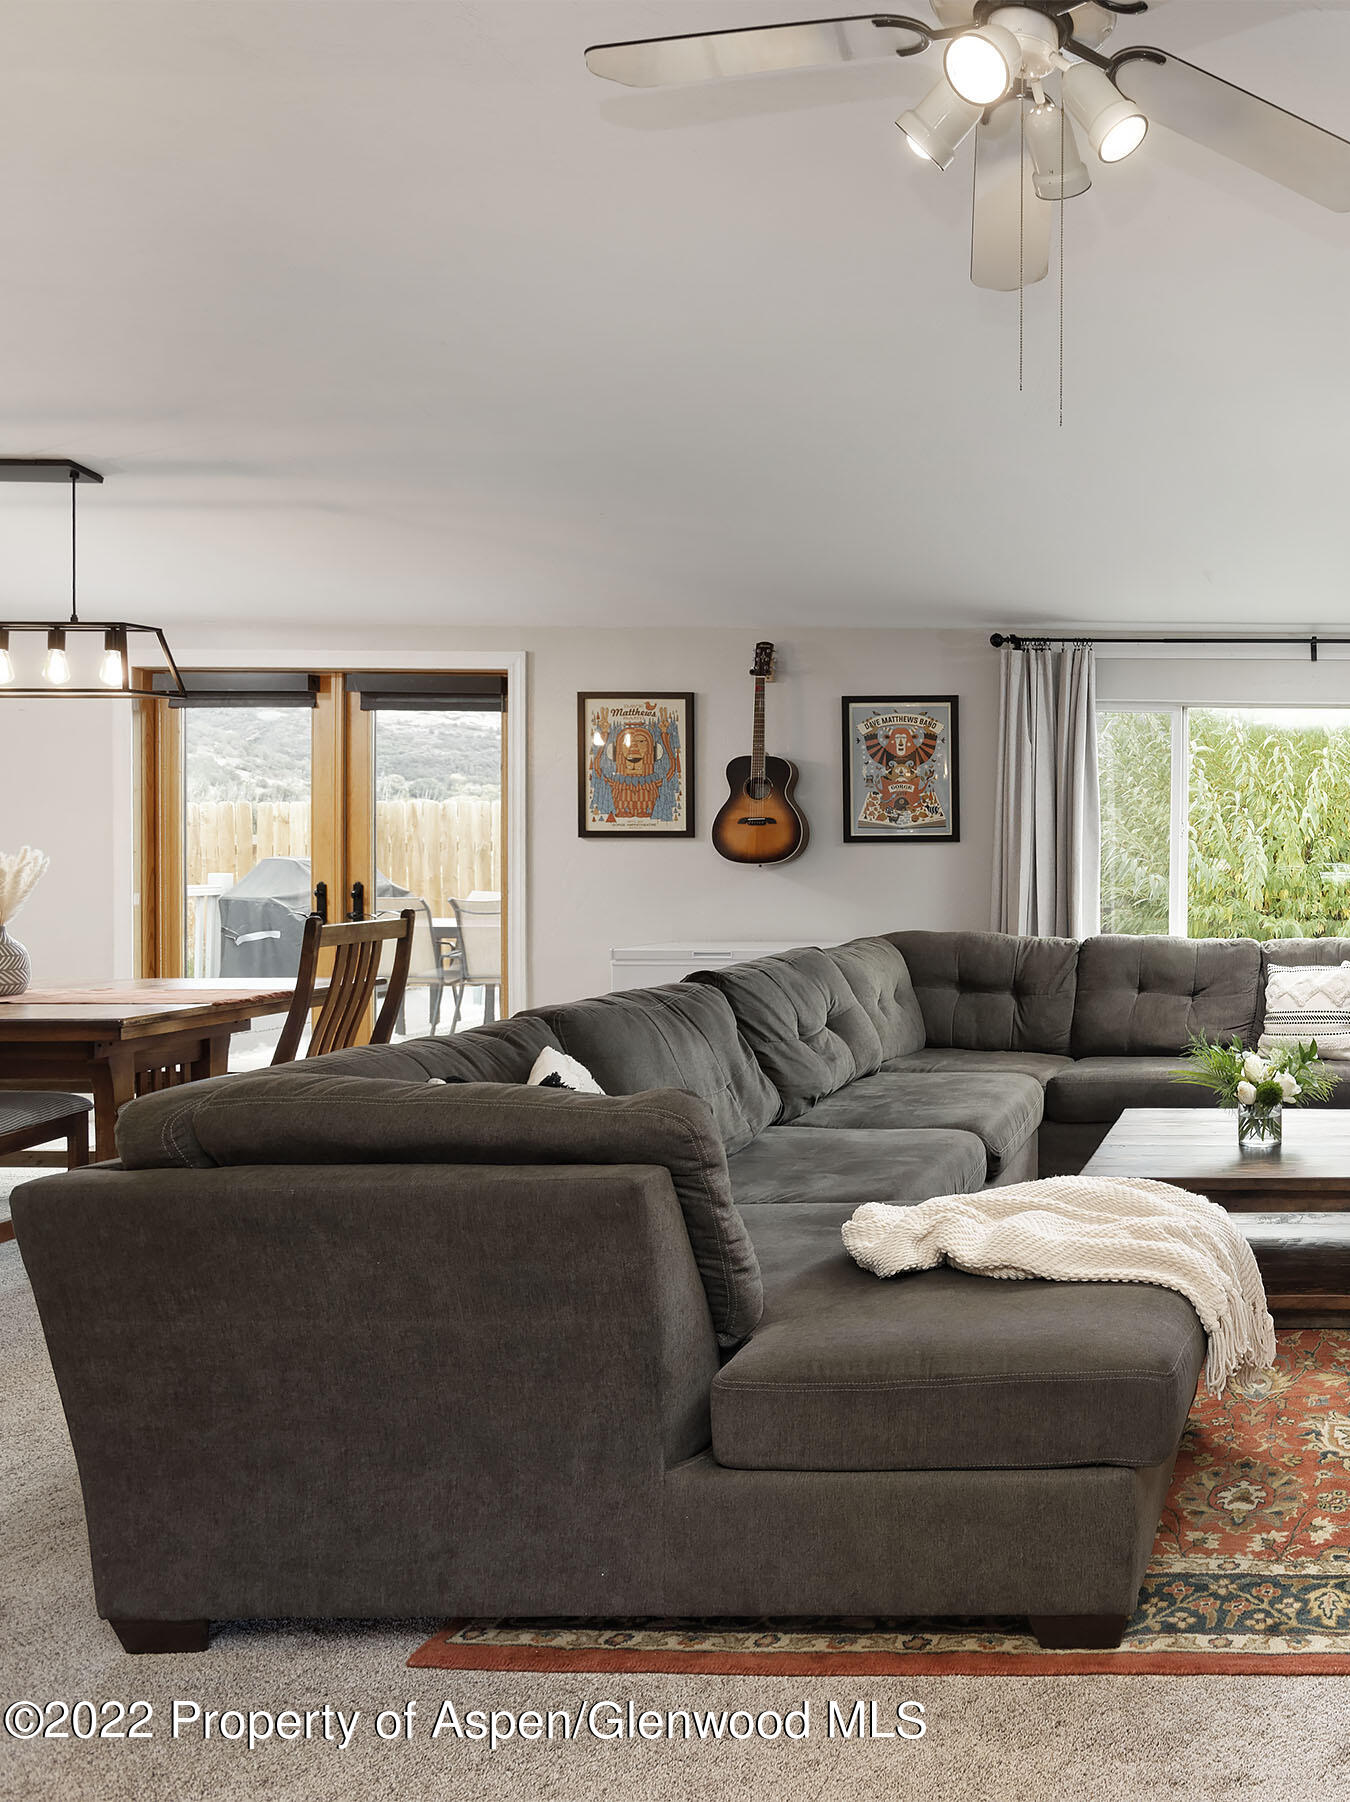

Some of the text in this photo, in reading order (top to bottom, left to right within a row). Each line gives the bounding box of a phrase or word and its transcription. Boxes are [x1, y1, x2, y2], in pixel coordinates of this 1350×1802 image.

[610, 708, 657, 718] Matthews
[864, 715, 938, 729] DAVE MATTHEWS BAND
